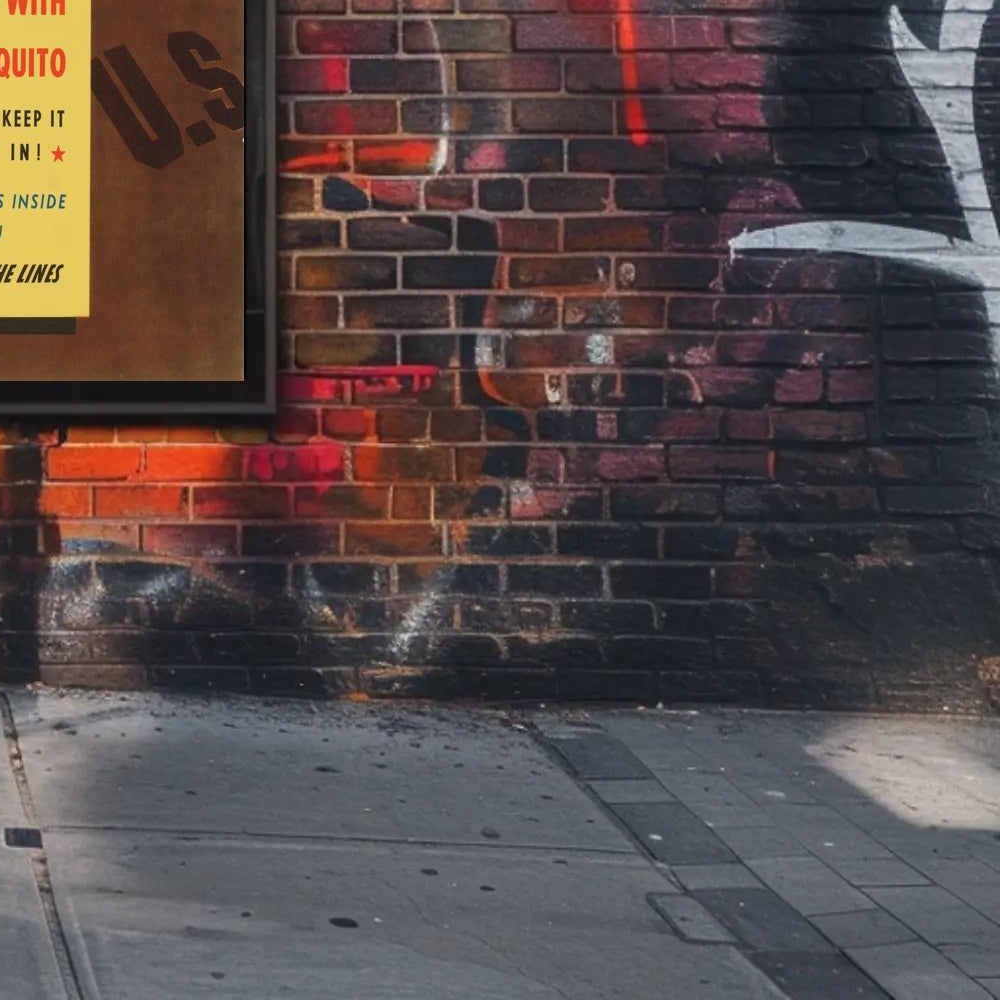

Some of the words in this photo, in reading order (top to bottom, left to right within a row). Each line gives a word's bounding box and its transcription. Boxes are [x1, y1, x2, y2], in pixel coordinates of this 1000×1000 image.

[2, 109, 42, 127] KEEP
[50, 110, 65, 127] IT
[10, 143, 41, 161] IN!
[12, 194, 67, 209] INSIDE
[16, 263, 64, 283] LINES
